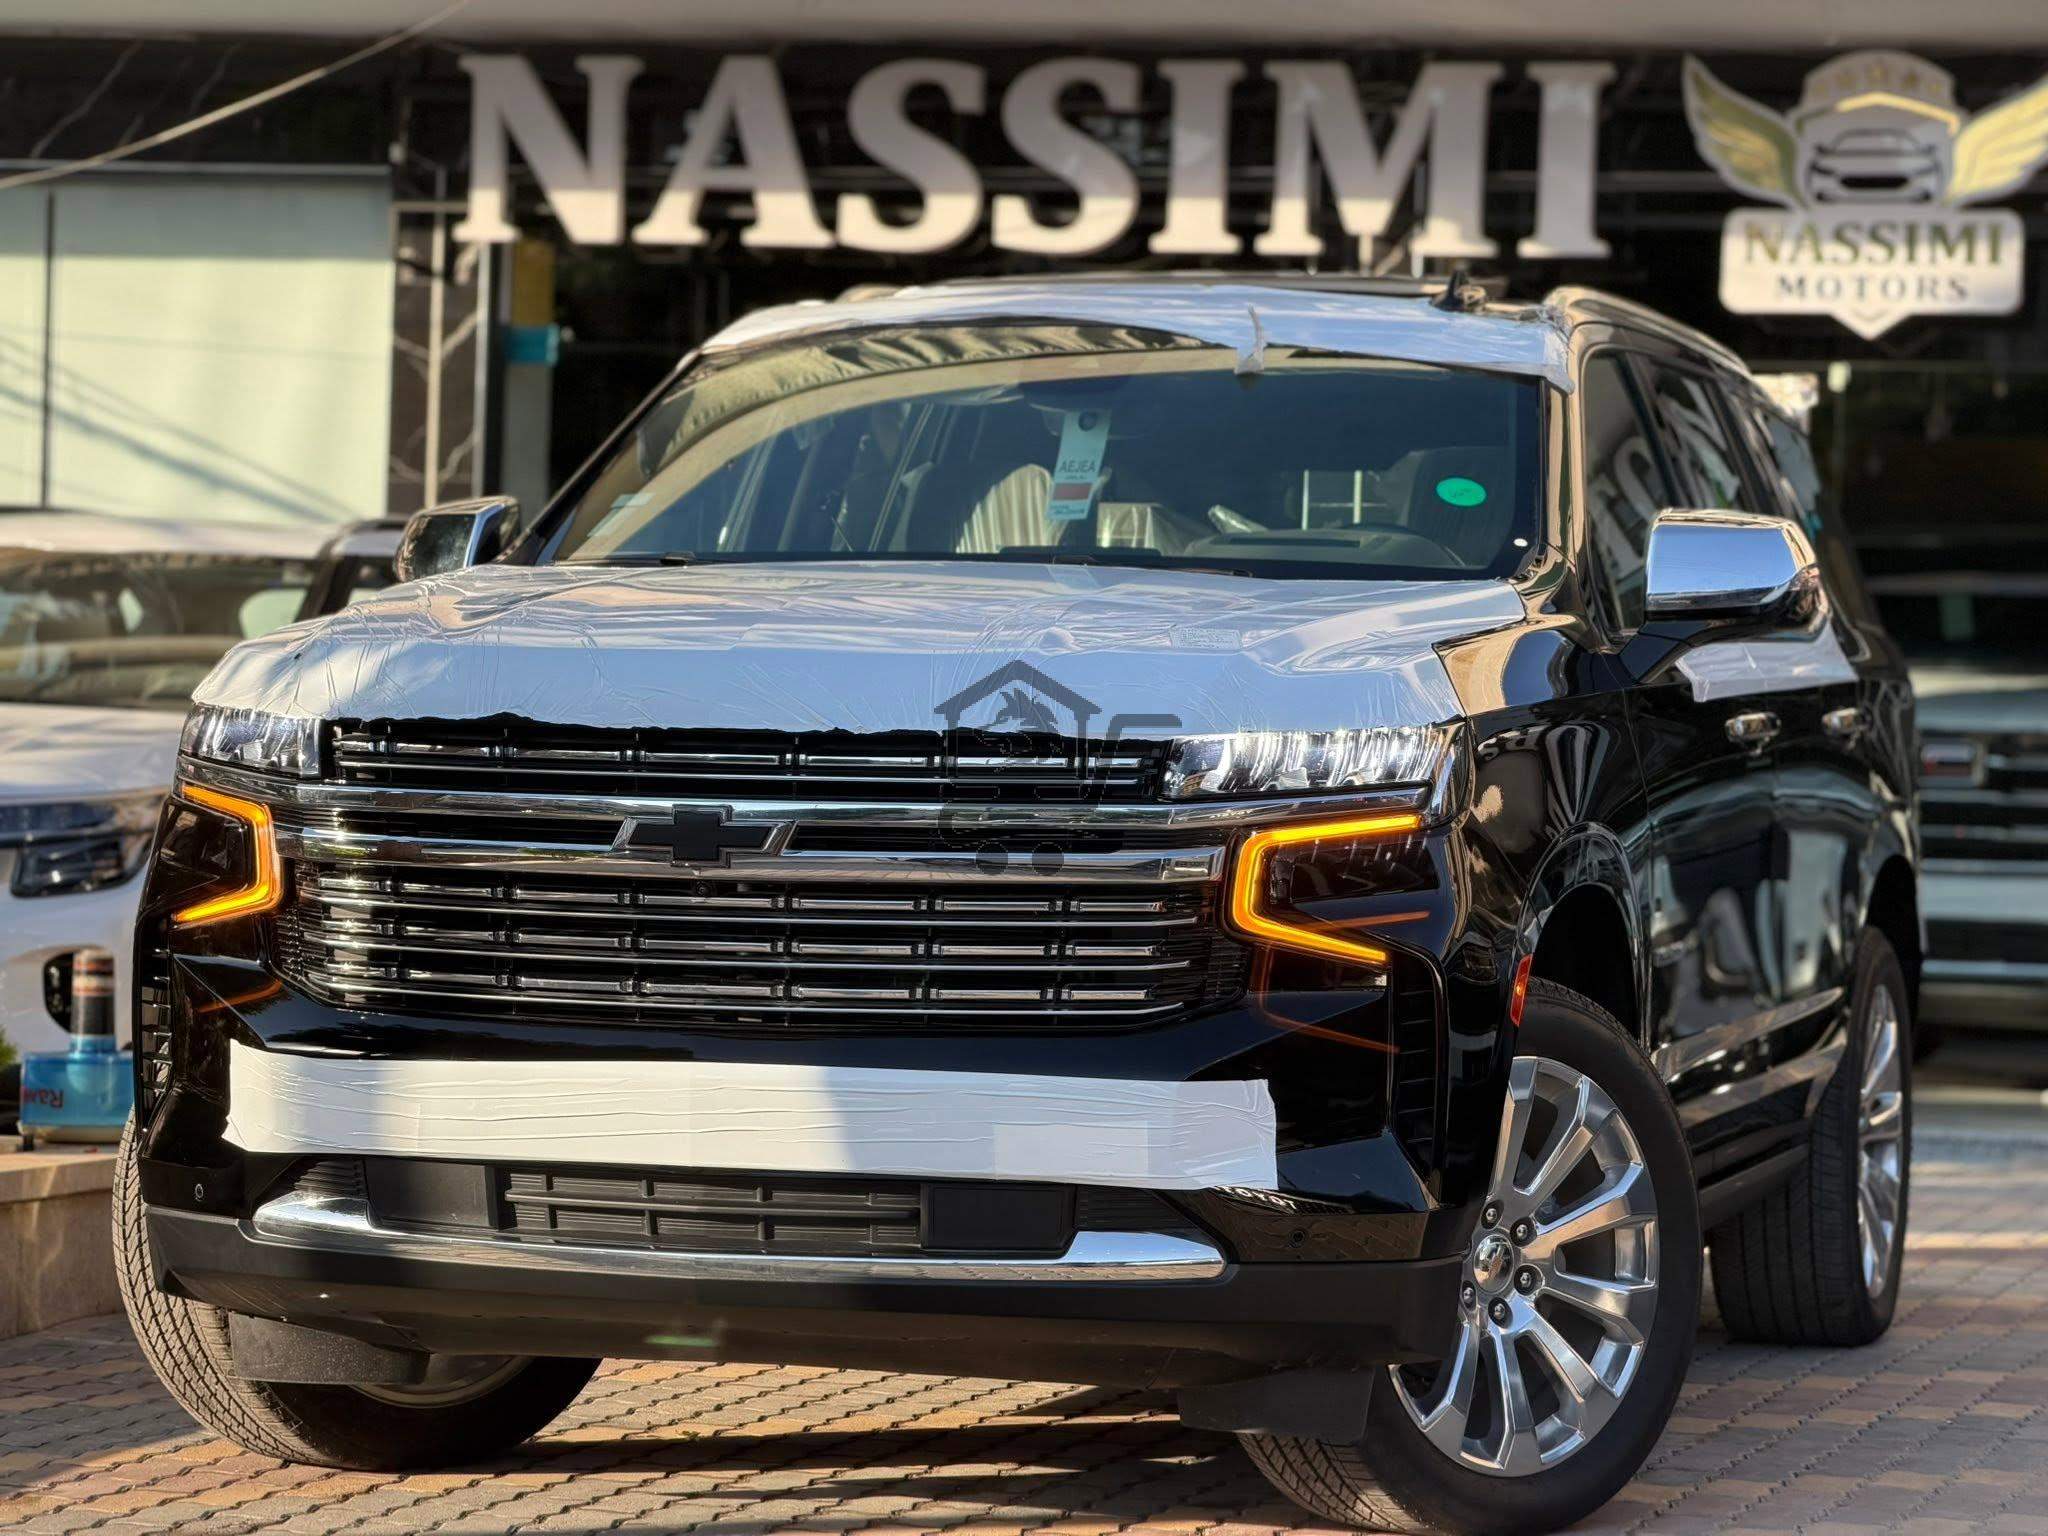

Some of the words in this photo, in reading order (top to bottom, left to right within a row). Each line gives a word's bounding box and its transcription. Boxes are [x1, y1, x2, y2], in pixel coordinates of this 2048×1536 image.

[452, 54, 1617, 260] NASSIMI
[1744, 221, 2005, 266] NASSIMI
[1777, 272, 1969, 302] MOTORS
